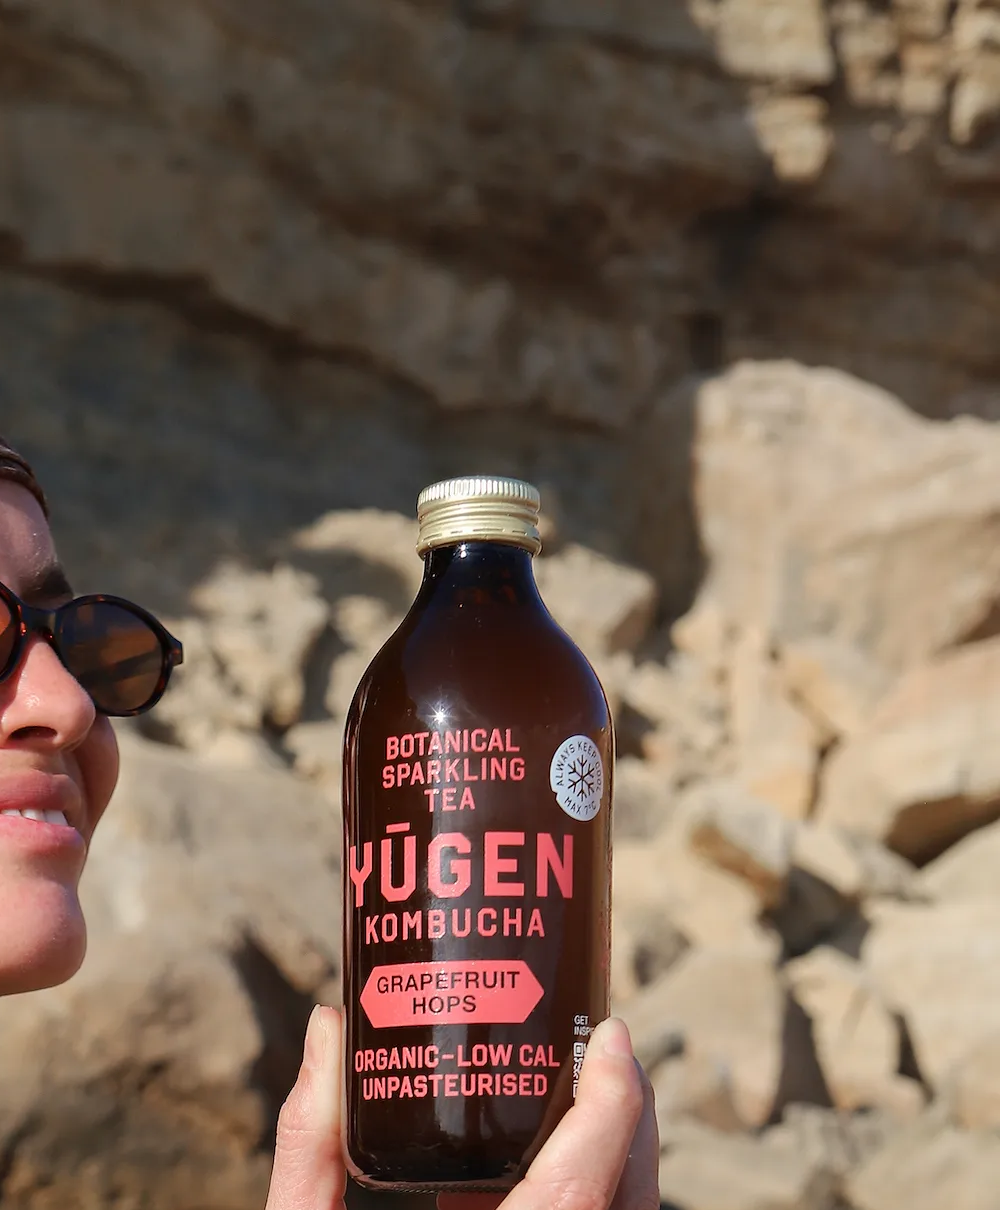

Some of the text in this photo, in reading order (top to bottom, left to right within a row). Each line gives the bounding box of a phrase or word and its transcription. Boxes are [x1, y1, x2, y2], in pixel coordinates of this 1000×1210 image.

[386, 728, 520, 760] BOTANICAL
[382, 757, 526, 789] SPARKLING
[556, 743, 576, 786] ALWAYS
[577, 741, 597, 760] KEEP
[423, 787, 476, 813] TEA
[564, 797, 583, 815] MAX
[349, 823, 574, 909] YŪGEN
[365, 908, 545, 945] KOMBUCHA
[376, 970, 521, 995] GRAPEFRUIT
[412, 995, 477, 1015] HOPS
[573, 1014, 589, 1026] GET
[519, 1043, 561, 1069] CAL
[362, 1072, 549, 1101] UNPASTEURISED
